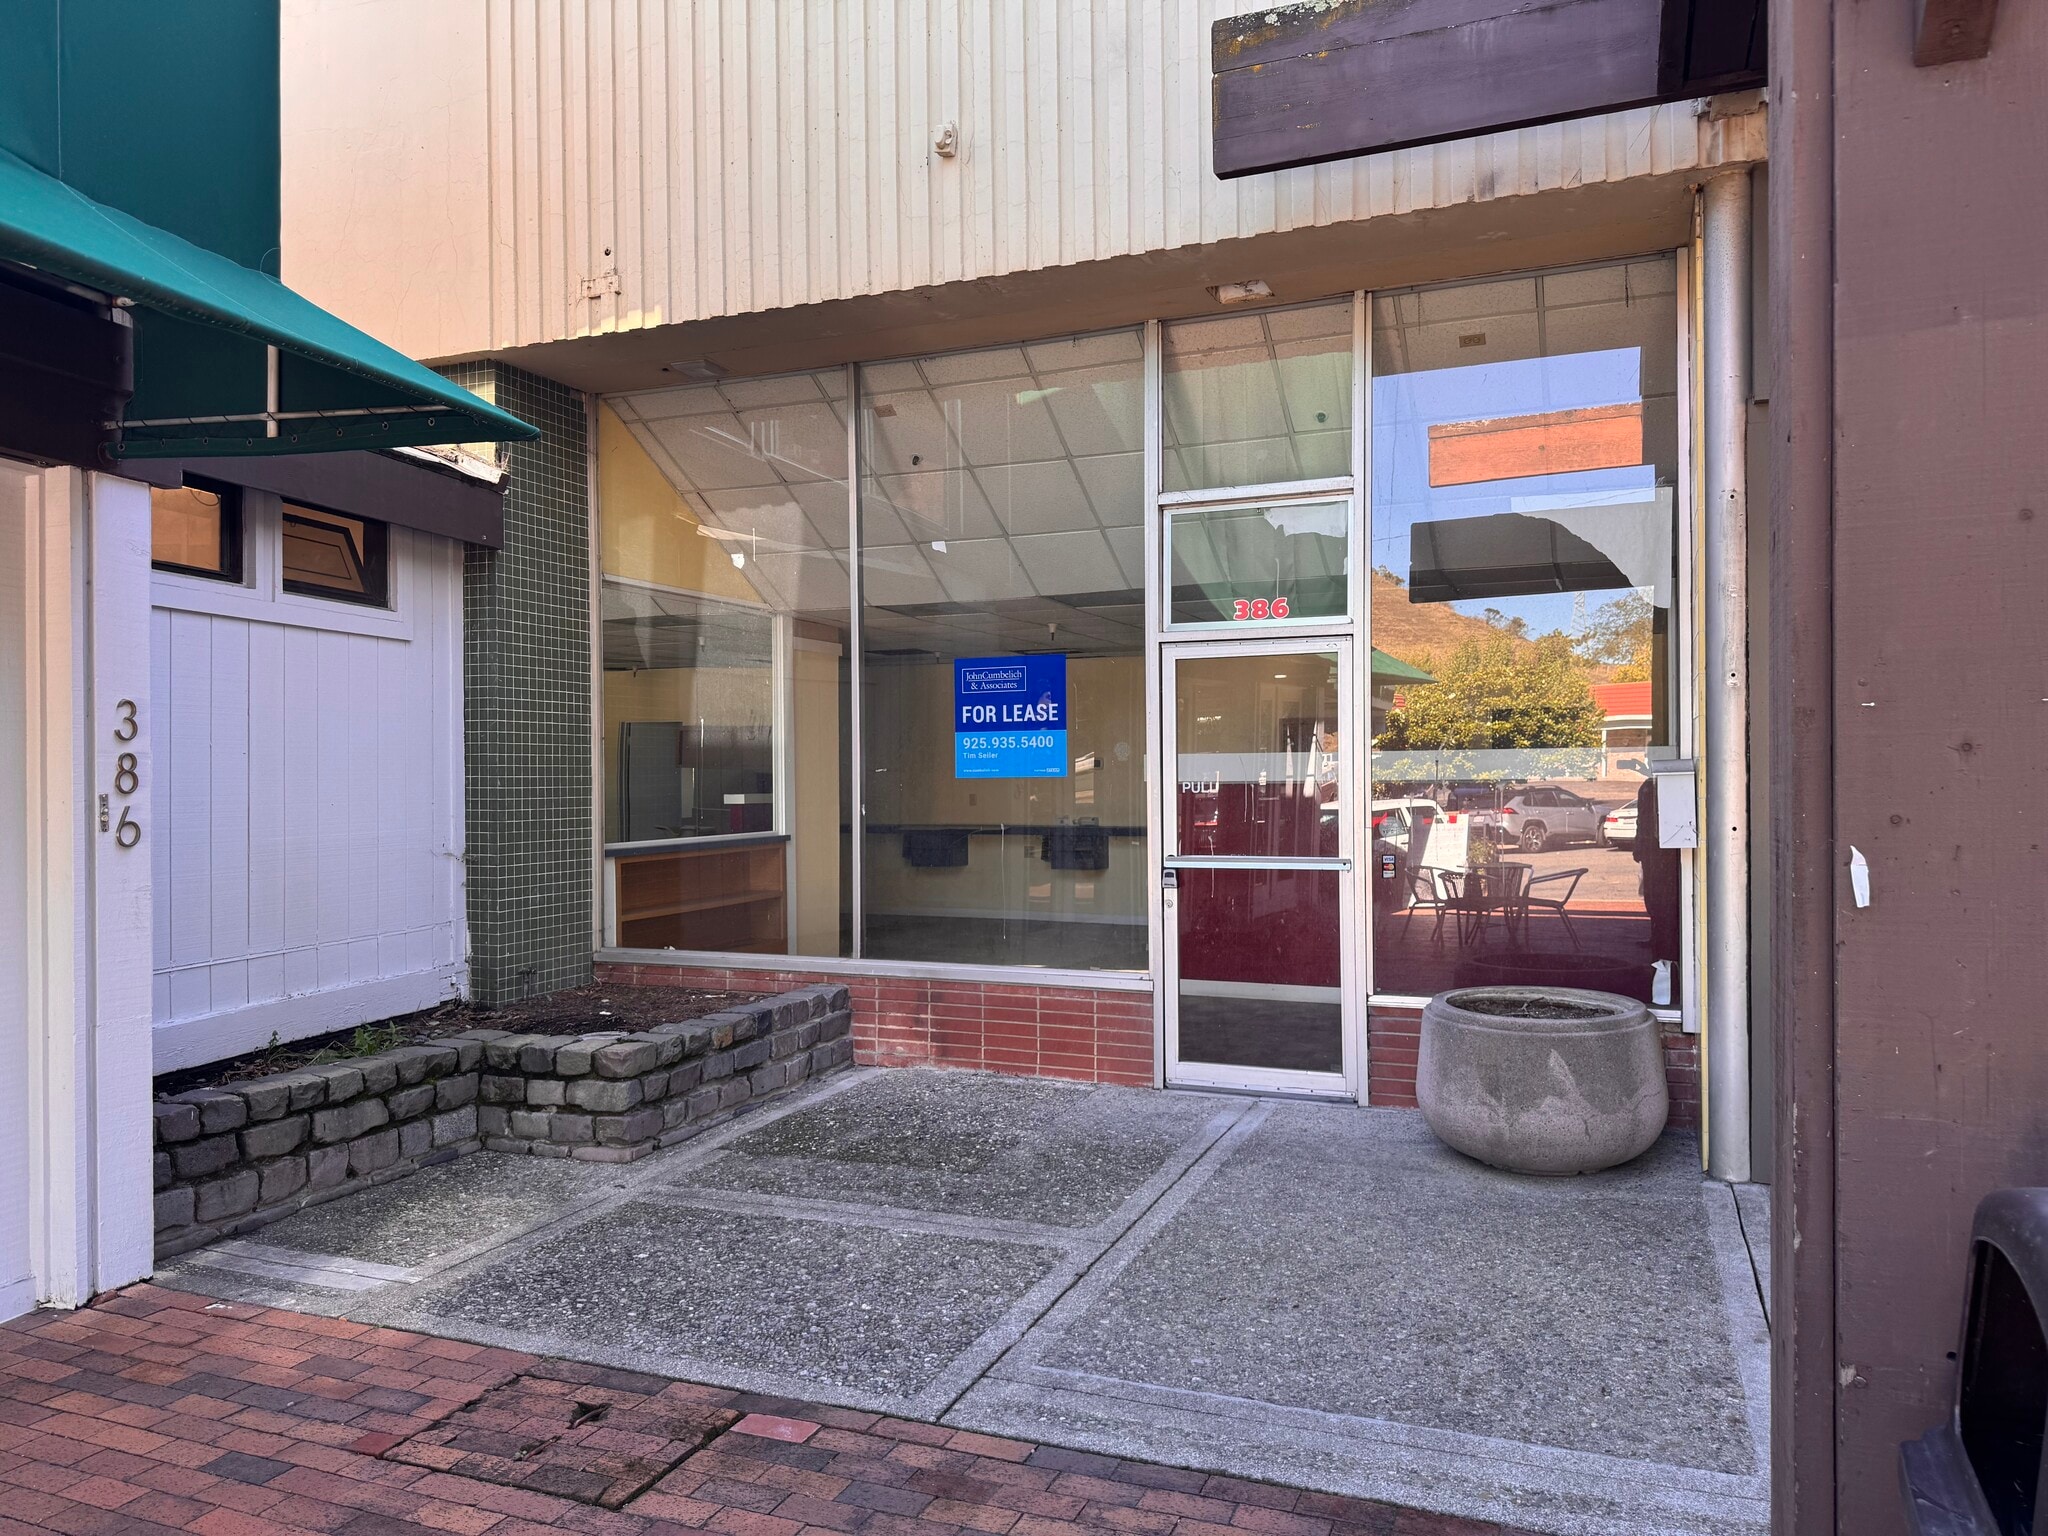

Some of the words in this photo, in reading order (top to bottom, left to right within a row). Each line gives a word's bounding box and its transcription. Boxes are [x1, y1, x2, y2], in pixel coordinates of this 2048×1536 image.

[1233, 598, 1290, 621] 386
[971, 682, 978, 690] &
[981, 681, 1018, 690] Associates
[963, 705, 997, 723] FOR
[1003, 704, 1058, 722] LEASE
[963, 736, 1054, 749] 925.935.5400
[114, 698, 141, 848] 386
[1182, 781, 1218, 794] PULL
